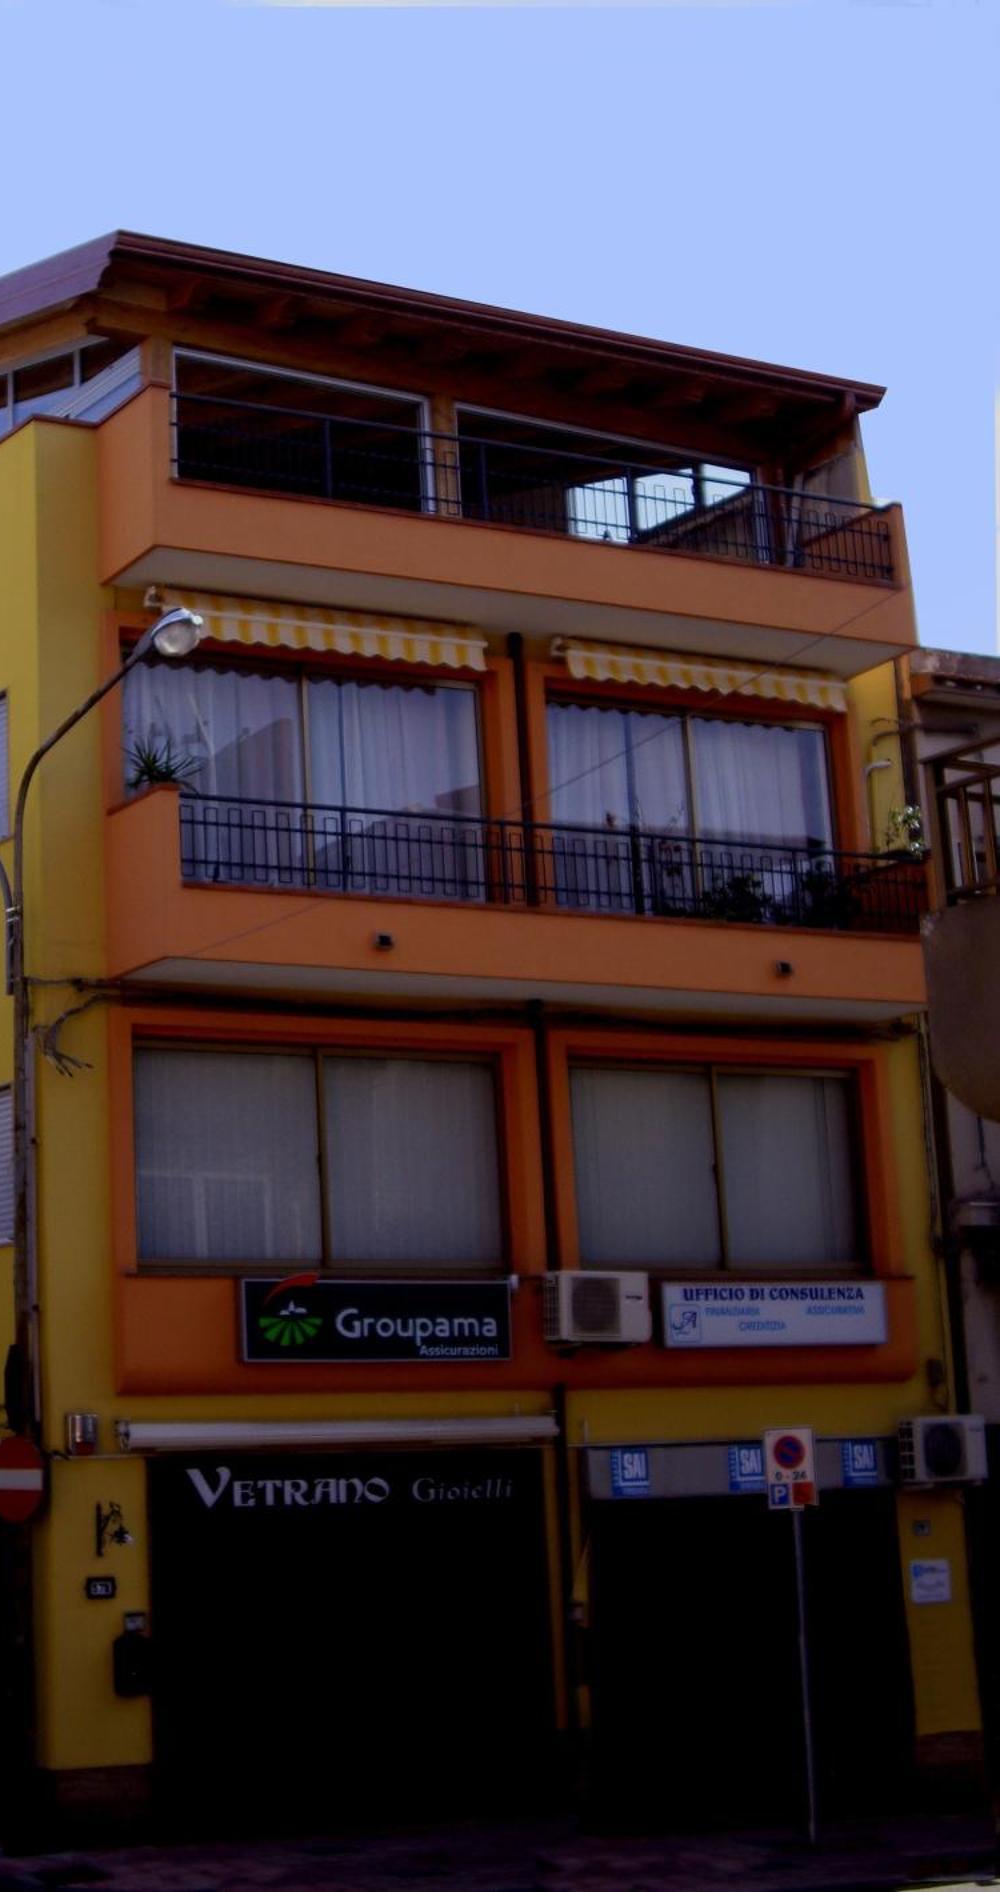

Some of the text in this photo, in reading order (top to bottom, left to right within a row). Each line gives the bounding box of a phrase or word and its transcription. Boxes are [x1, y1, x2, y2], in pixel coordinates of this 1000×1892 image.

[683, 1287, 864, 1301] UFFICIO DI CONSULENZA
[334, 1307, 498, 1346] Groupama
[418, 1344, 499, 1357] Assicurazioni
[623, 1452, 648, 1479] SAI
[740, 1448, 763, 1475] SAI
[852, 1443, 875, 1470] SAI
[411, 1476, 514, 1503] Gioielli
